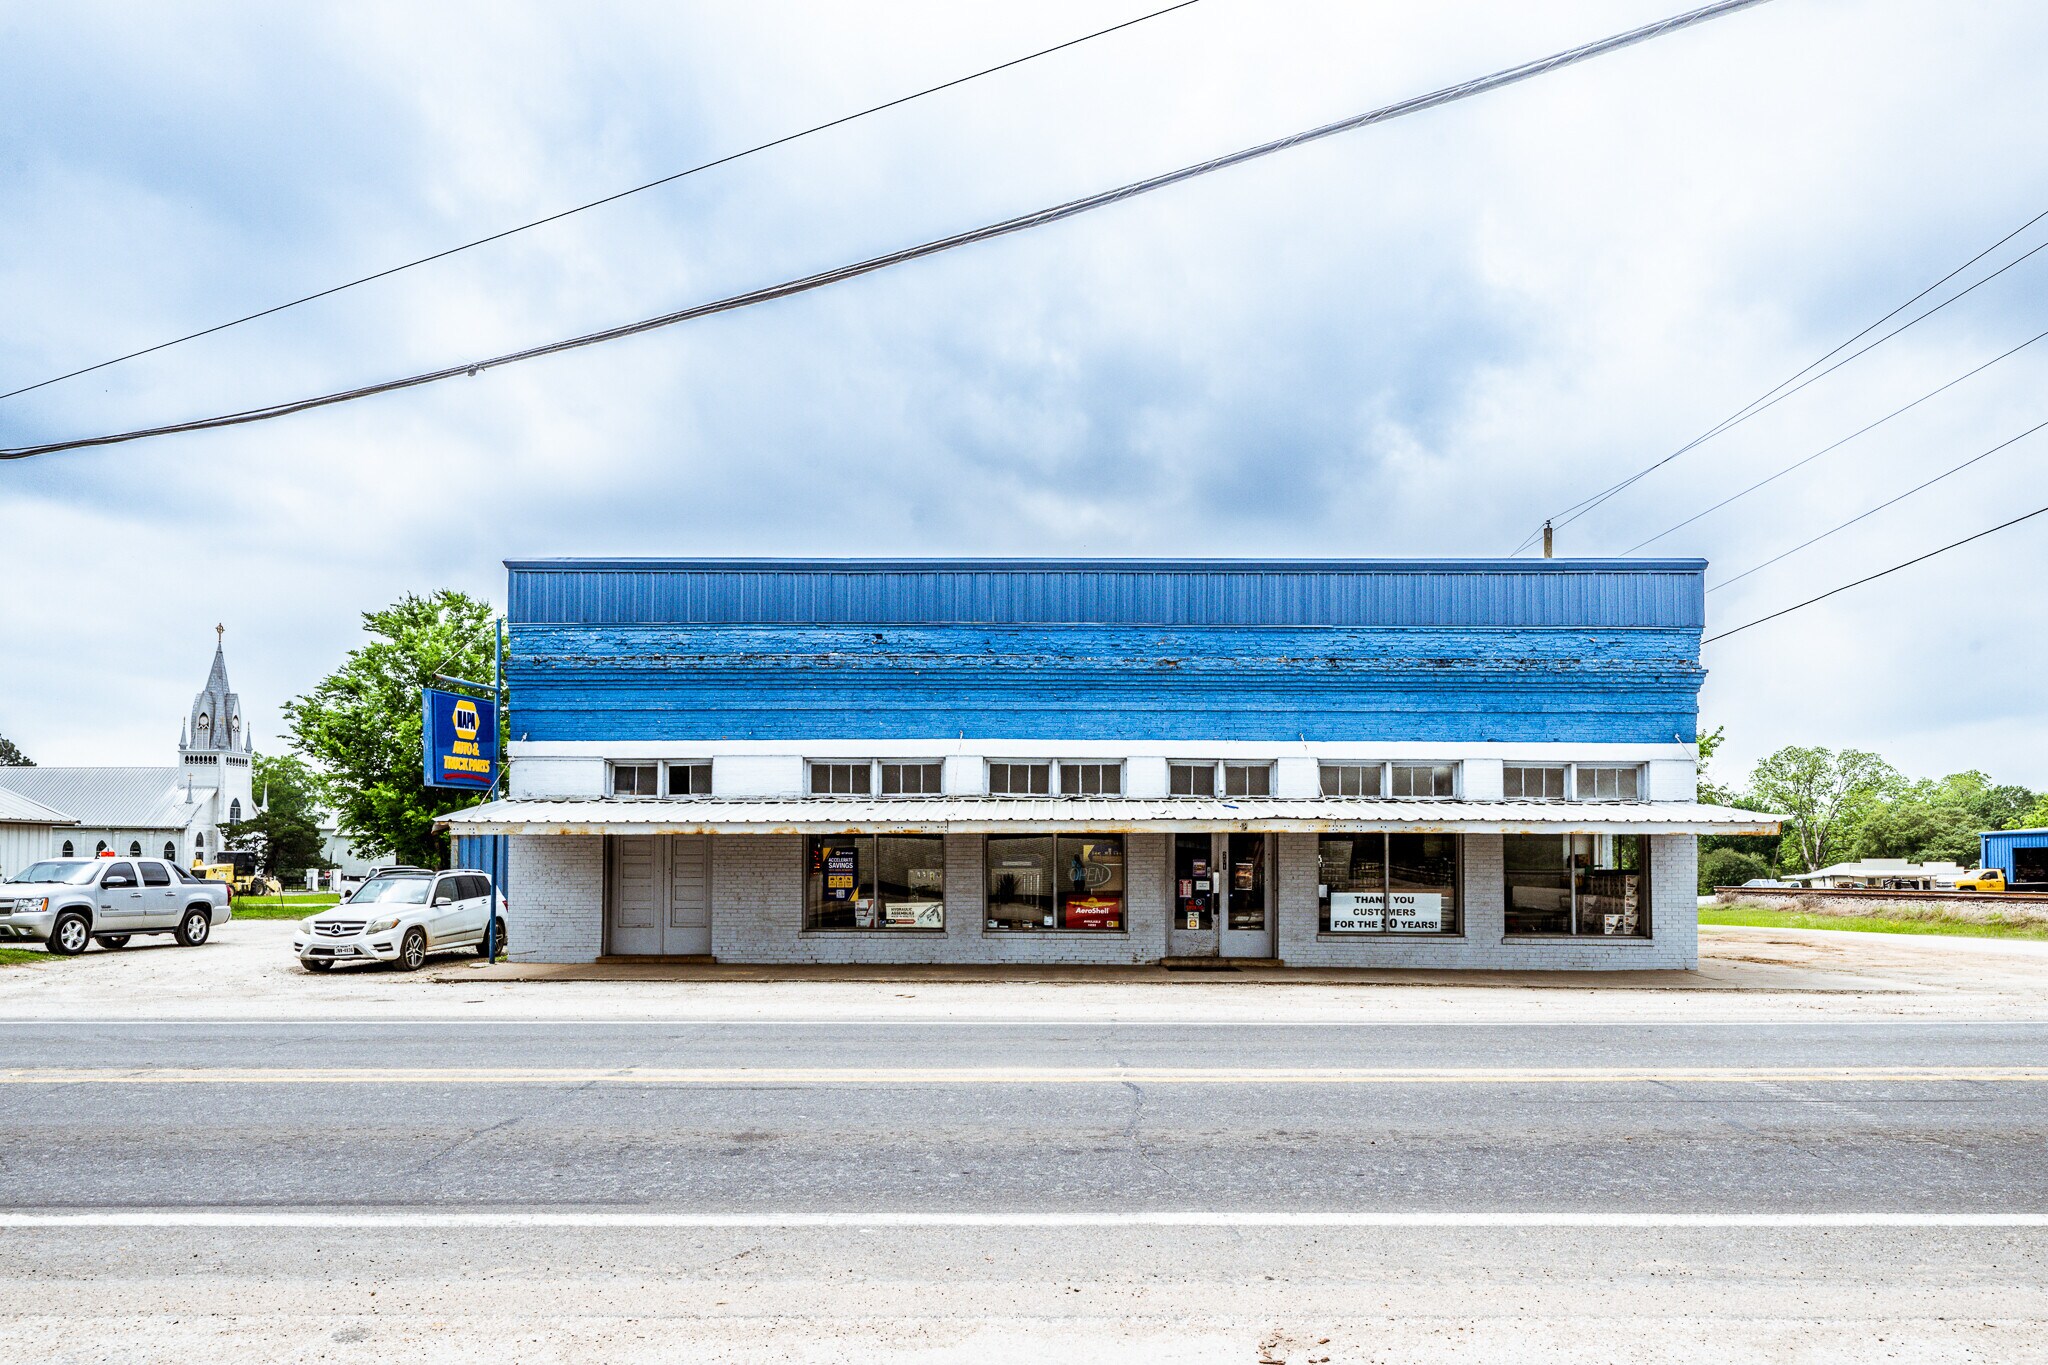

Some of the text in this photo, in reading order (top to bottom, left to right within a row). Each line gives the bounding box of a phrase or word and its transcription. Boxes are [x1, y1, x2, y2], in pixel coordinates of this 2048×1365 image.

[457, 710, 476, 730] NAPA
[452, 741, 480, 756] AUTO &
[443, 755, 490, 773] TRUCK PARTS
[1069, 867, 1104, 882] OPEN
[1393, 896, 1415, 904] YOU
[1353, 908, 1416, 916] CUSTOMERS
[1334, 918, 1438, 929] FOR THE 50 YEARS!
